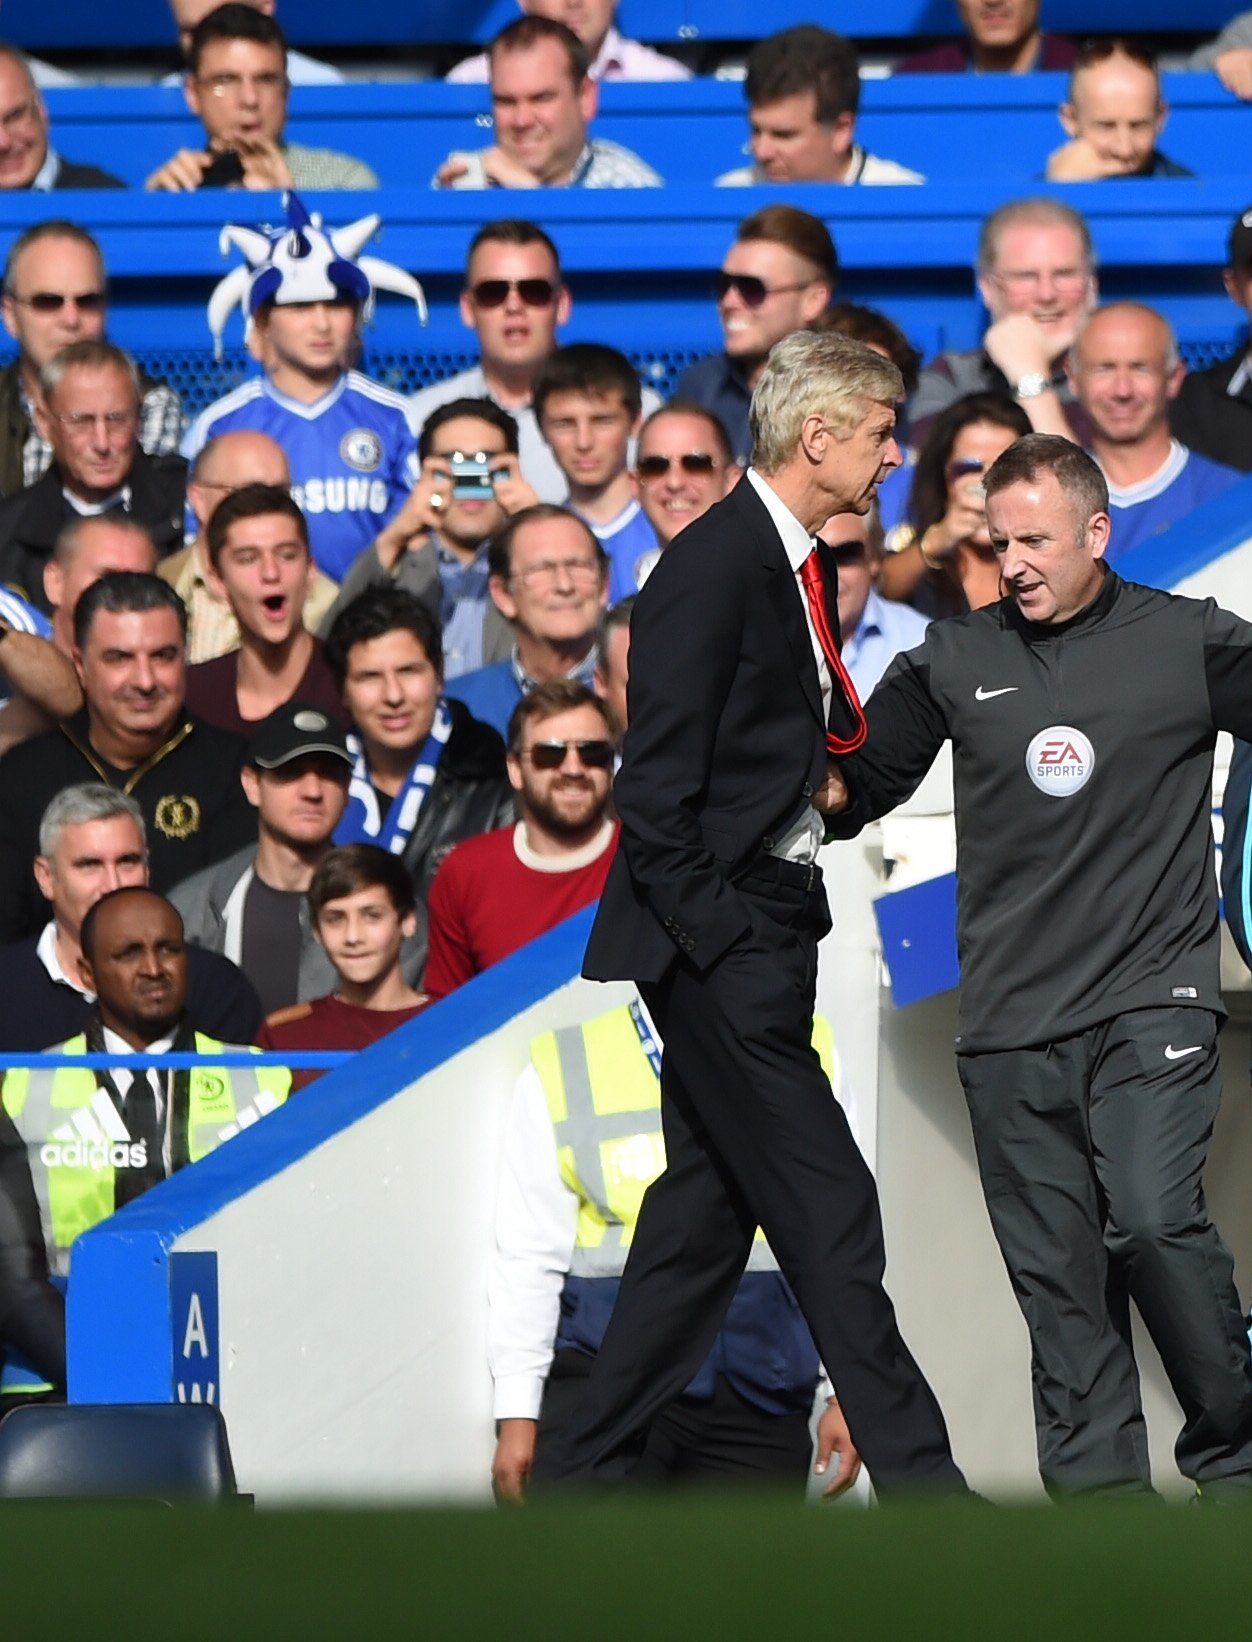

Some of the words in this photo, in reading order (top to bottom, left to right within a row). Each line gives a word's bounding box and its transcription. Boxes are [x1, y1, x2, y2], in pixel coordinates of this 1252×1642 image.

[1038, 741, 1083, 765] EA
[1037, 766, 1084, 782] SPORTS
[40, 1136, 148, 1169] adidas
